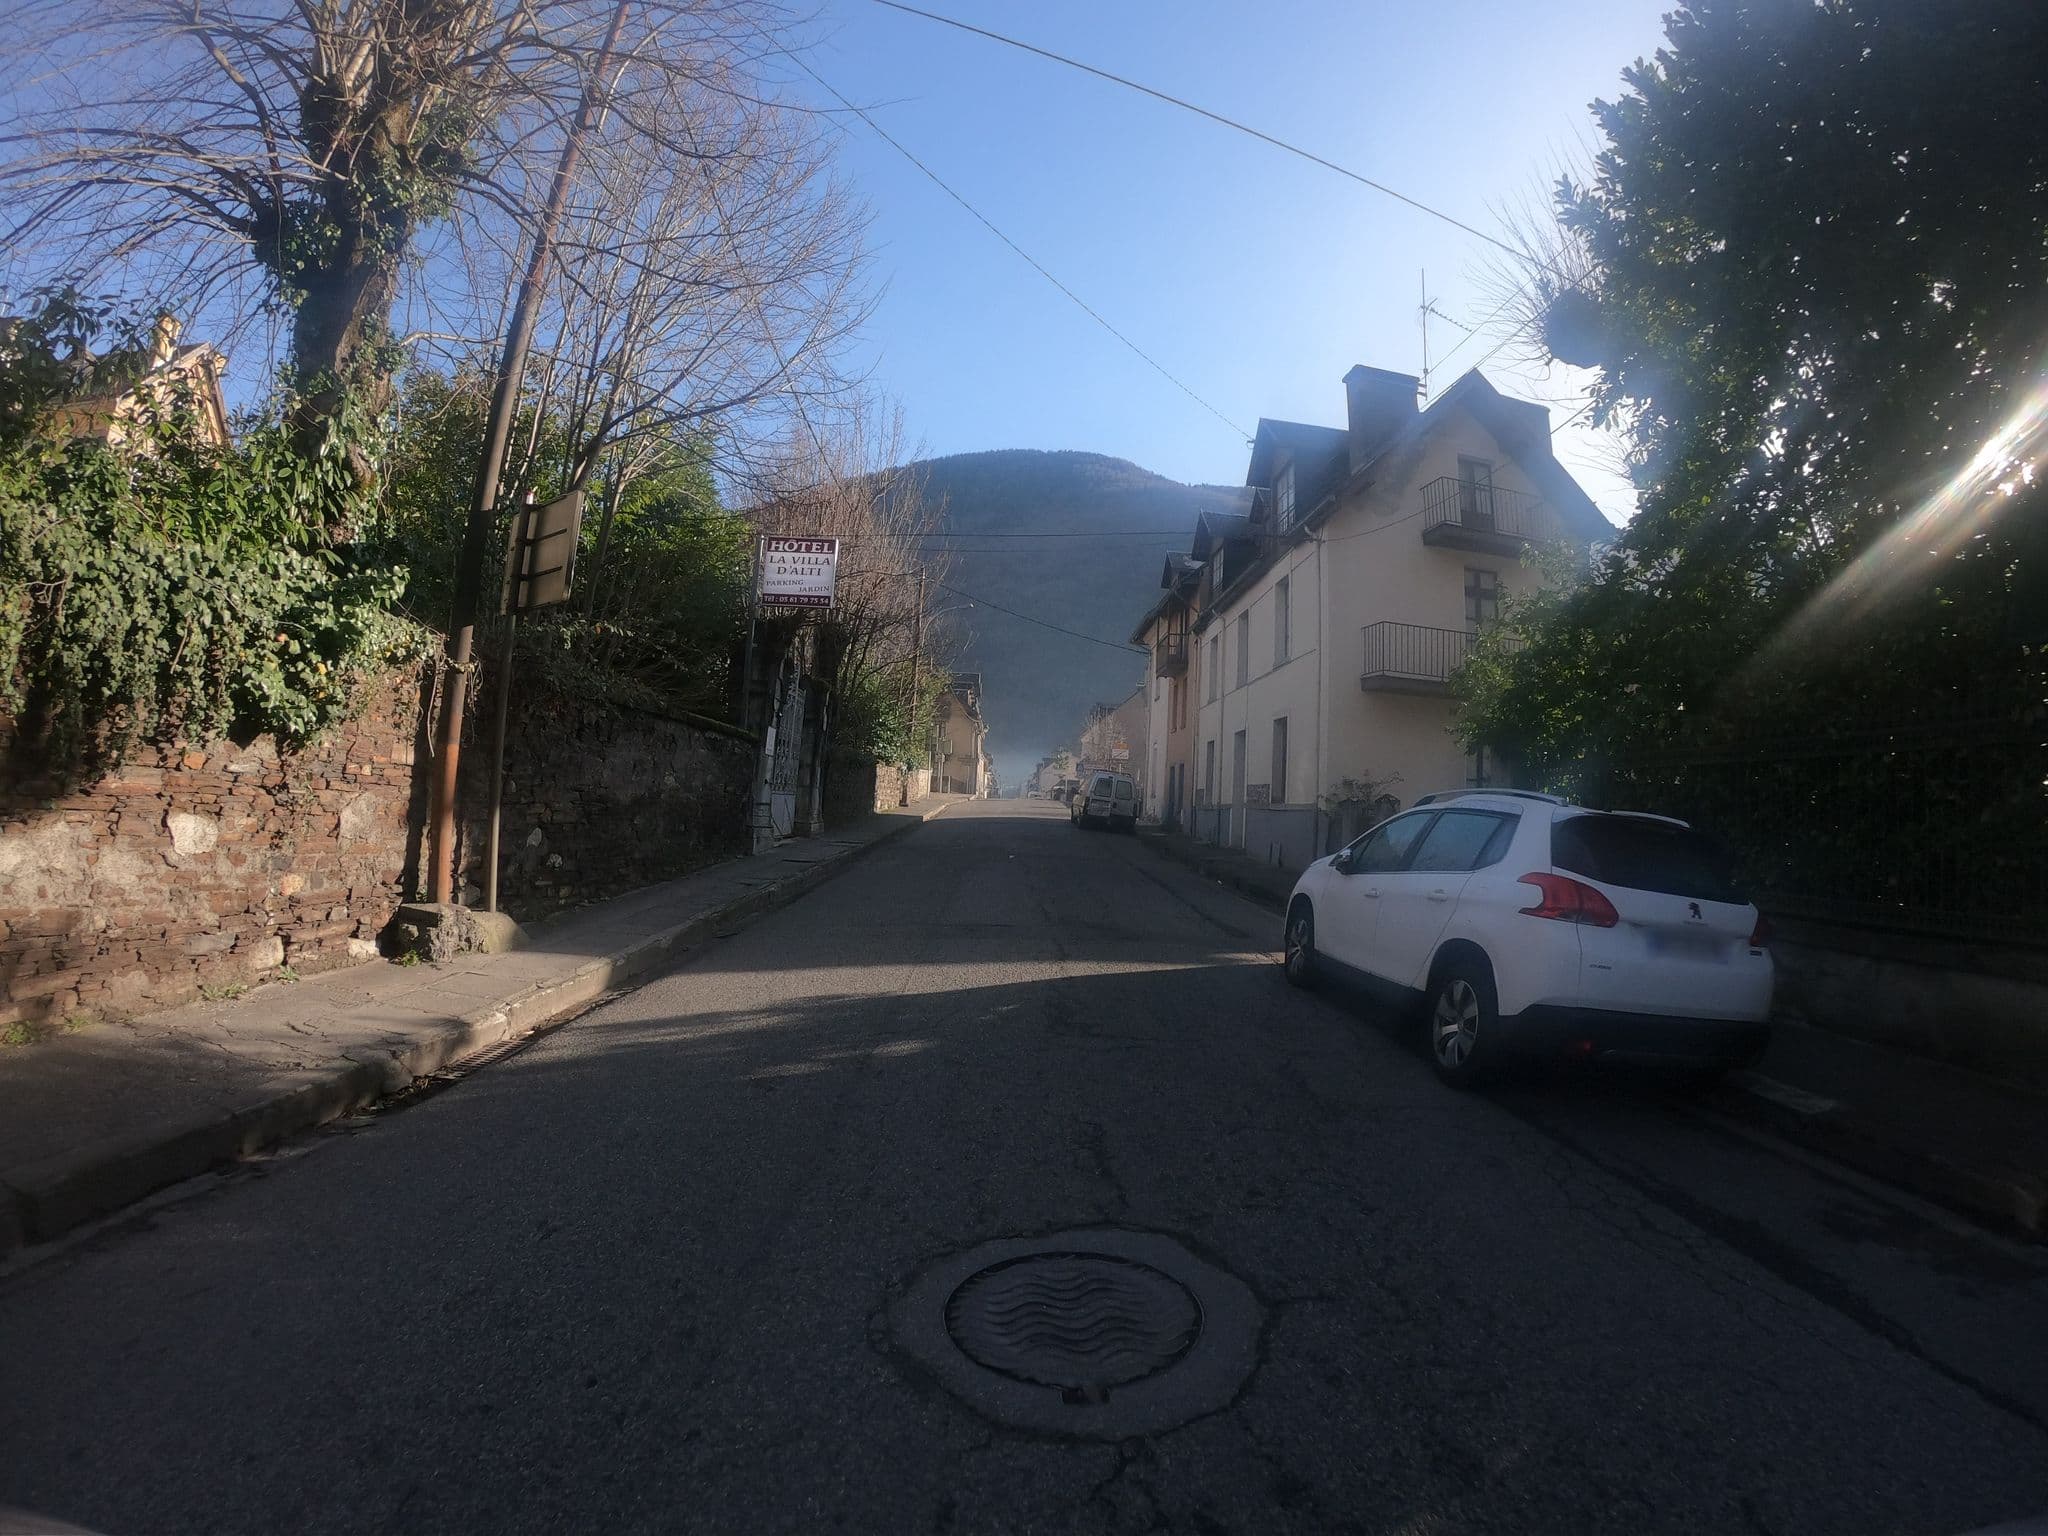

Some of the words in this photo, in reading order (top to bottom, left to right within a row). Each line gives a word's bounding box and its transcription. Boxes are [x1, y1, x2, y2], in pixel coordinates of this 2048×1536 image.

[770, 538, 832, 553] HÔTEL
[770, 556, 786, 564] LA
[792, 556, 830, 565] VILLA
[777, 566, 822, 576] D'ALTI
